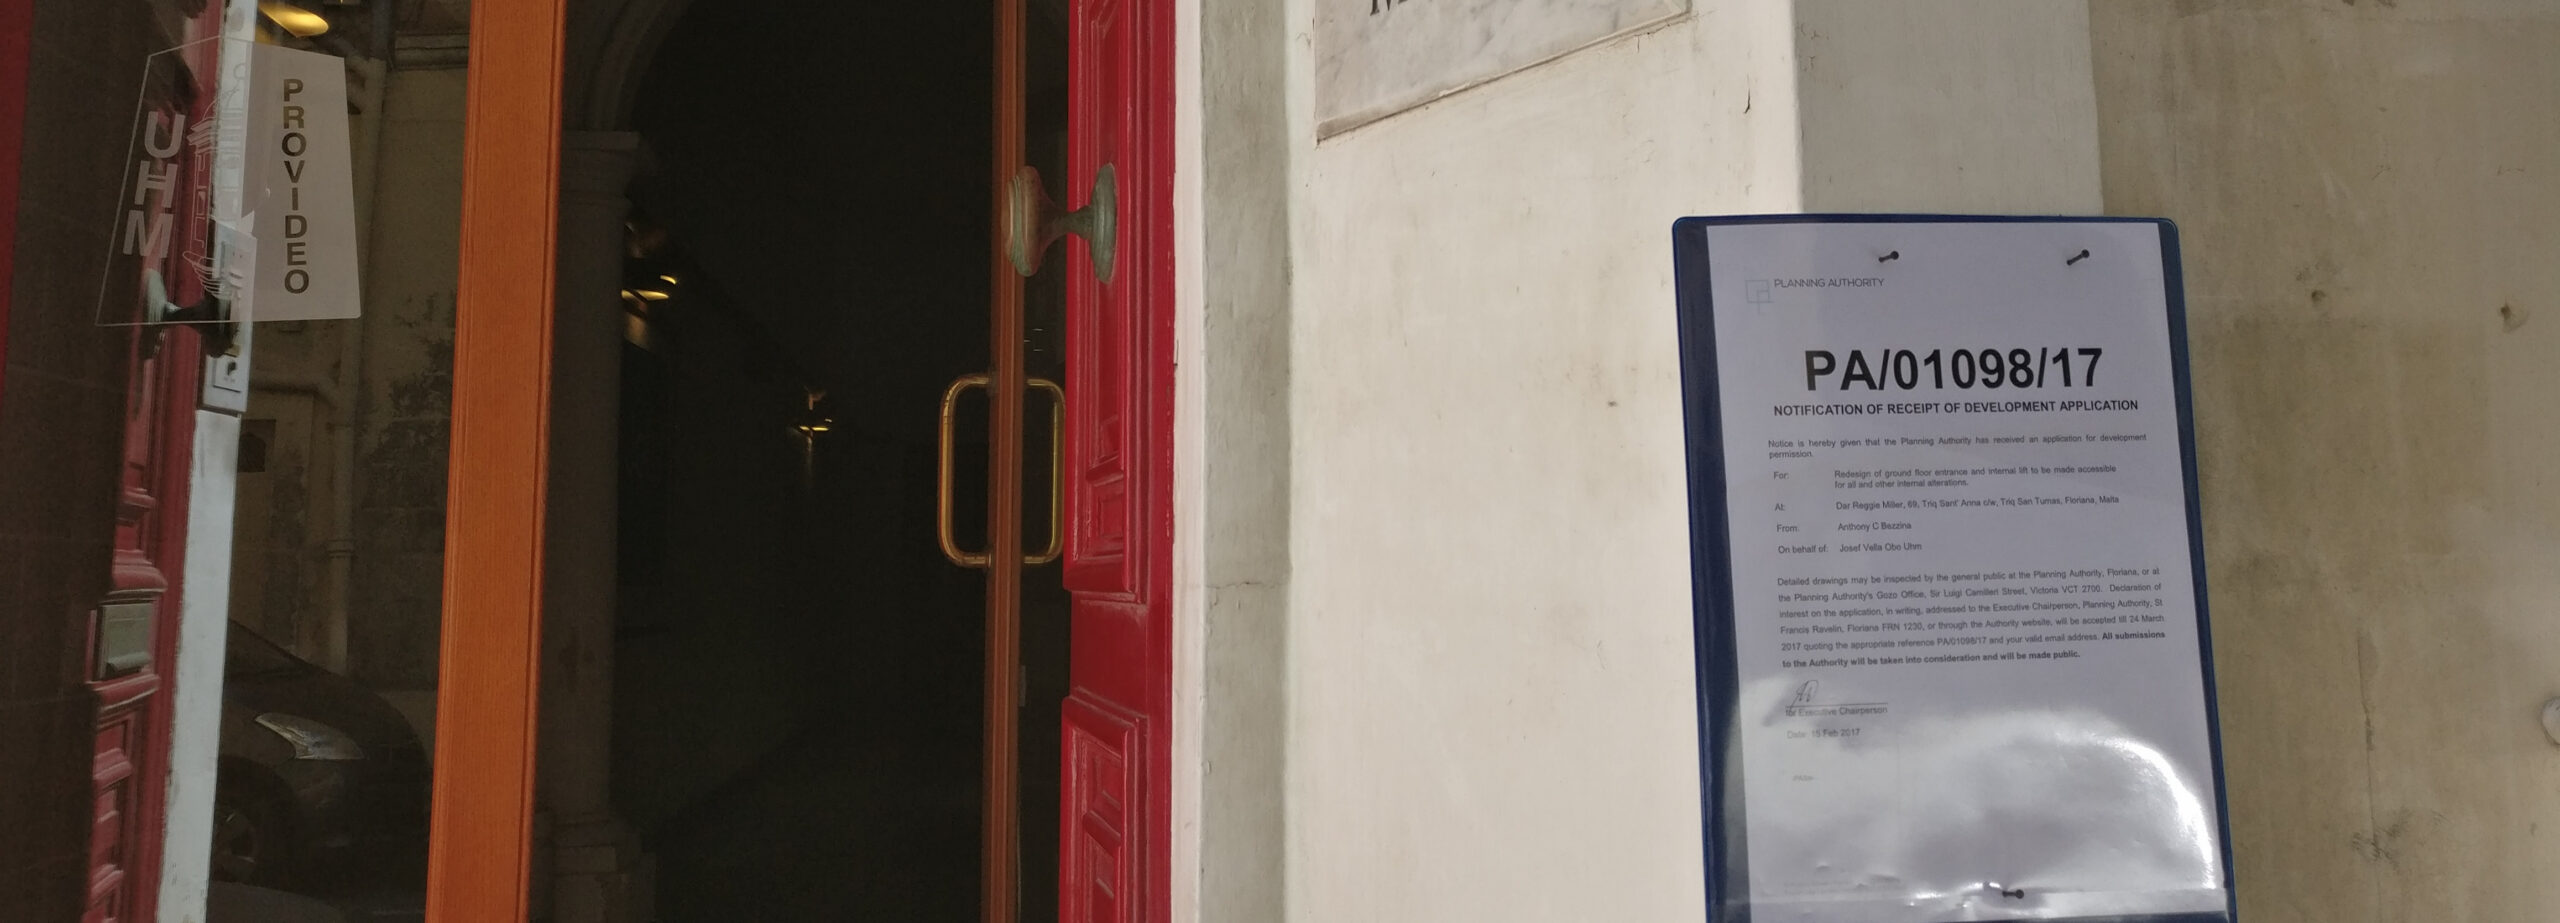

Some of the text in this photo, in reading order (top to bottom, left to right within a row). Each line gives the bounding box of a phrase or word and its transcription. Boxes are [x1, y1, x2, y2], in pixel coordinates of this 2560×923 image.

[122, 111, 184, 259] UHM
[282, 77, 310, 295] PROVIDEO
[1774, 278, 1885, 288] PLANNING AUTHORITY
[1804, 348, 2103, 391] PA/01098/17
[1774, 400, 2138, 416] NOTIFICATION OF RECEIPT OF DEVELOPMENT APPLICATION
[1768, 439, 1794, 448] Notice
[1797, 439, 1805, 447] is
[1808, 438, 1836, 449] hereby
[1840, 438, 1861, 448] given
[1865, 438, 1880, 446] that
[1884, 437, 1897, 446] the
[1900, 437, 1934, 447] Planning
[1938, 436, 1971, 447] Authority
[1975, 436, 1989, 444] has
[1993, 435, 2025, 444] received
[2042, 434, 2082, 445] application
[2085, 434, 2096, 442] for
[2100, 433, 2147, 444] development
[1834, 469, 1871, 480] Redesign
[1873, 469, 1882, 478] of
[1884, 469, 1912, 479] ground
[1914, 468, 1932, 477] floor
[1934, 467, 1968, 476] entrance
[1970, 467, 1985, 476] and
[1988, 466, 2016, 475] internal
[2019, 466, 2028, 475] lift
[2030, 466, 2039, 474] to
[2041, 466, 2051, 474] be
[2053, 465, 2075, 474] made
[2077, 464, 2116, 473] accessible
[1834, 478, 1968, 489] for all and other internal alterations.
[1836, 501, 1851, 510] Dar
[1852, 500, 1881, 511] Reggie
[1882, 500, 1906, 510] Miller,
[1961, 498, 1981, 507] Anna
[2017, 497, 2033, 506] San
[2099, 495, 2119, 504] Malta
[1838, 521, 1912, 533] Anthony C Bezzina
[1778, 542, 1922, 554] On behalf Josef Vella Obo Uhm
[1777, 577, 1810, 586] Detailed
[1812, 576, 1848, 587] drawings
[1851, 577, 1869, 586] may
[1870, 575, 1881, 583] be
[1883, 573, 1921, 585] inspected
[1924, 573, 1934, 583] by
[1936, 573, 1948, 581] the
[1951, 572, 1981, 583] general
[1983, 571, 2006, 582] public
[2008, 571, 2016, 579] at
[2018, 570, 2031, 579] the
[2033, 569, 2066, 580] Planning
[2070, 568, 2104, 579] Authority,
[2152, 567, 2160, 575] at
[1778, 582, 2162, 603] the Planning Authority's Gozo Office, Sir Luigi Camilleri Street, Victoria VCT Declaration of
[1779, 608, 1808, 618] interest
[1824, 608, 1836, 616] the
[1839, 606, 1884, 618] application,
[1886, 606, 1893, 615] in
[1895, 605, 1923, 616] writing,
[1926, 604, 1966, 613] addressed
[1968, 604, 1976, 612] to
[1978, 603, 1990, 612] the
[1993, 602, 2030, 611] Executive
[2032, 601, 2080, 612] Chairperson,
[2082, 600, 2115, 611] Planning
[2117, 599, 2152, 610] Authority,
[2154, 598, 2163, 607] St
[1780, 625, 1809, 634] Francis
[1812, 624, 1844, 634] Ravelin,
[1847, 623, 1879, 632] Floriana
[1882, 622, 1900, 631] FRN
[1938, 620, 1968, 631] through
[1971, 619, 1983, 628] the
[1985, 618, 2019, 629] Authority
[2021, 617, 2053, 627] website,
[2055, 617, 2068, 625] will
[2070, 616, 2080, 625] be
[2082, 615, 2116, 626] accepted
[2118, 615, 2127, 623] till
[2129, 614, 2139, 623] 24
[2141, 613, 2165, 622] March
[1781, 642, 1801, 651] 2017
[1803, 641, 1833, 652] quoting
[1835, 640, 1848, 649] the
[1850, 639, 1895, 650] appropriate
[1897, 637, 1935, 647] reference
[1989, 635, 2003, 644] and
[2006, 636, 2022, 645] your
[2025, 634, 2042, 643] valid
[2044, 633, 2065, 642] email
[2101, 632, 2113, 640] All
[2115, 630, 2166, 640] submissions
[1782, 649, 2081, 669] to the Authority will be taken into consideration and will be made public.
[1839, 706, 1888, 716] Chairperson
[1823, 728, 1861, 737] Feb 2017
